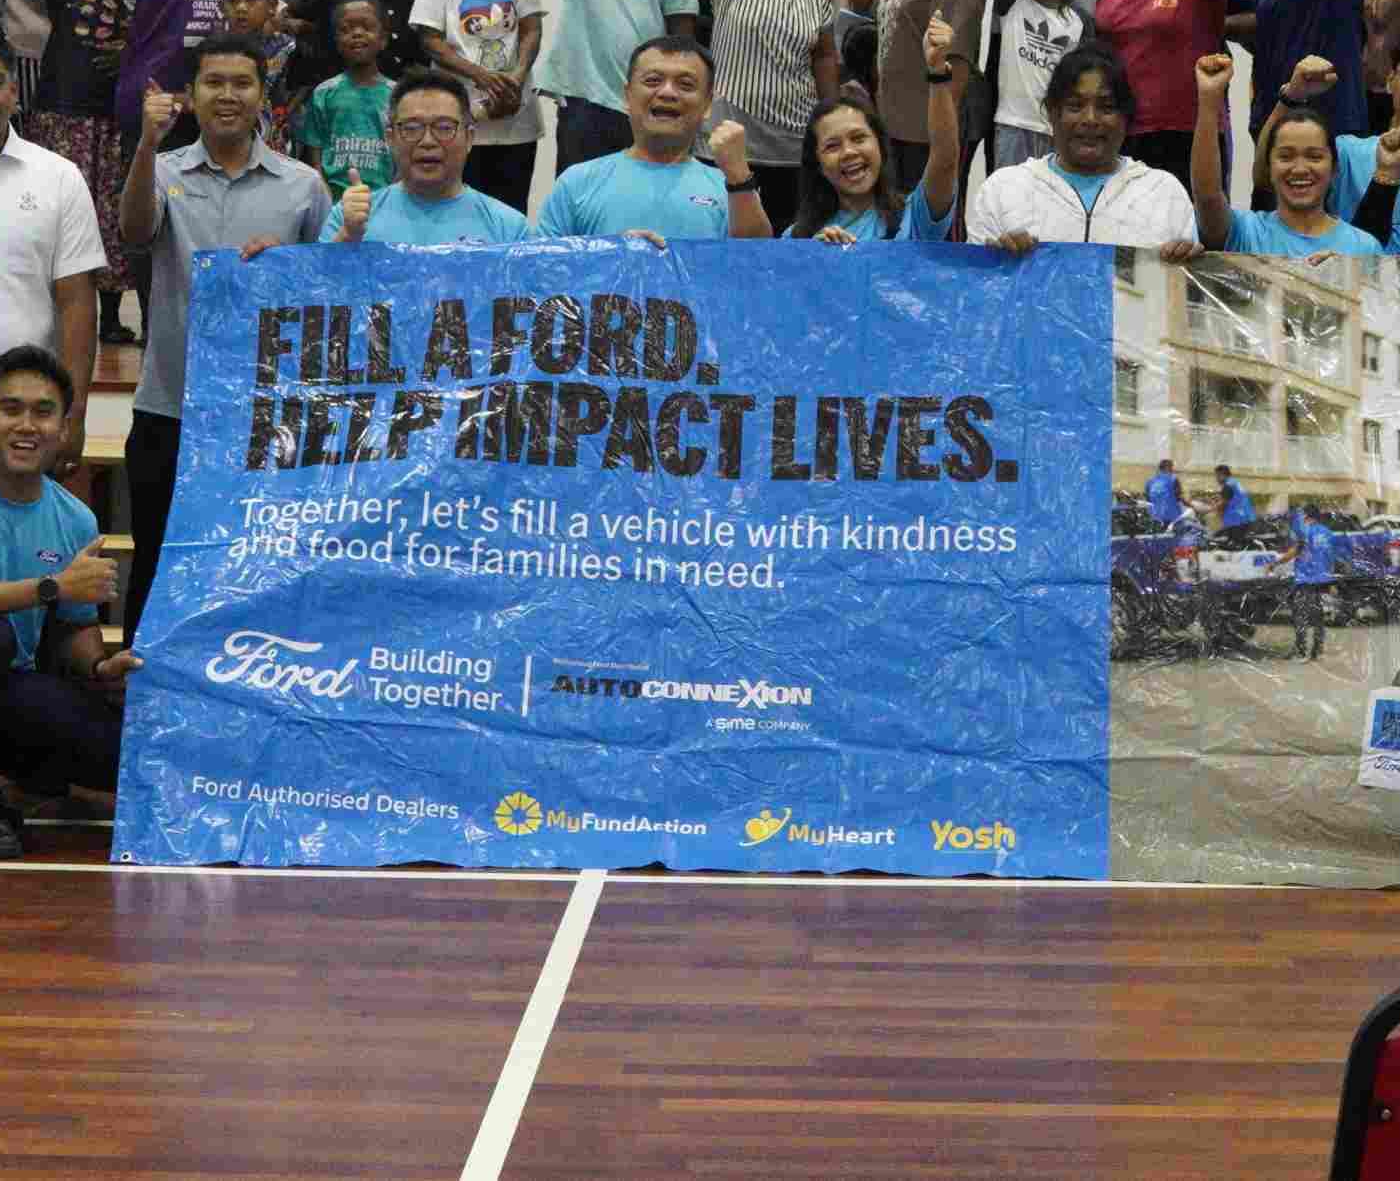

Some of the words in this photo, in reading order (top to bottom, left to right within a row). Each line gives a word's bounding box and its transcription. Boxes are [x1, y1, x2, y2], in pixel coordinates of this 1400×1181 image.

[1018, 46, 1057, 74] adida
[254, 300, 407, 387] FILL
[419, 298, 474, 382] A
[489, 293, 721, 386] FORD.
[246, 388, 444, 472] HELP
[455, 381, 755, 480] IMPACT
[770, 393, 1019, 483] LIVES.
[240, 494, 408, 532] Together,
[421, 491, 500, 523] let's
[511, 497, 557, 525] fill
[568, 510, 590, 538] a
[601, 507, 736, 547] vehicle
[747, 515, 830, 551] with
[842, 515, 1017, 553] kindness
[227, 526, 297, 566] and
[308, 530, 394, 564] food
[406, 532, 468, 570] for
[470, 541, 621, 581] families
[634, 548, 670, 583] in
[679, 552, 786, 589] need.
[204, 630, 359, 700] Ford
[368, 676, 503, 714] Together
[369, 646, 494, 683] Building
[551, 674, 813, 709] AUTOCONNEXION
[715, 717, 757, 731] sime
[191, 775, 242, 801] Ford
[247, 782, 370, 813] Authorised
[376, 794, 460, 820] Dealers
[547, 808, 707, 836] MyFundAction
[787, 824, 896, 846] MyHeart
[930, 819, 1017, 850] Yosh
